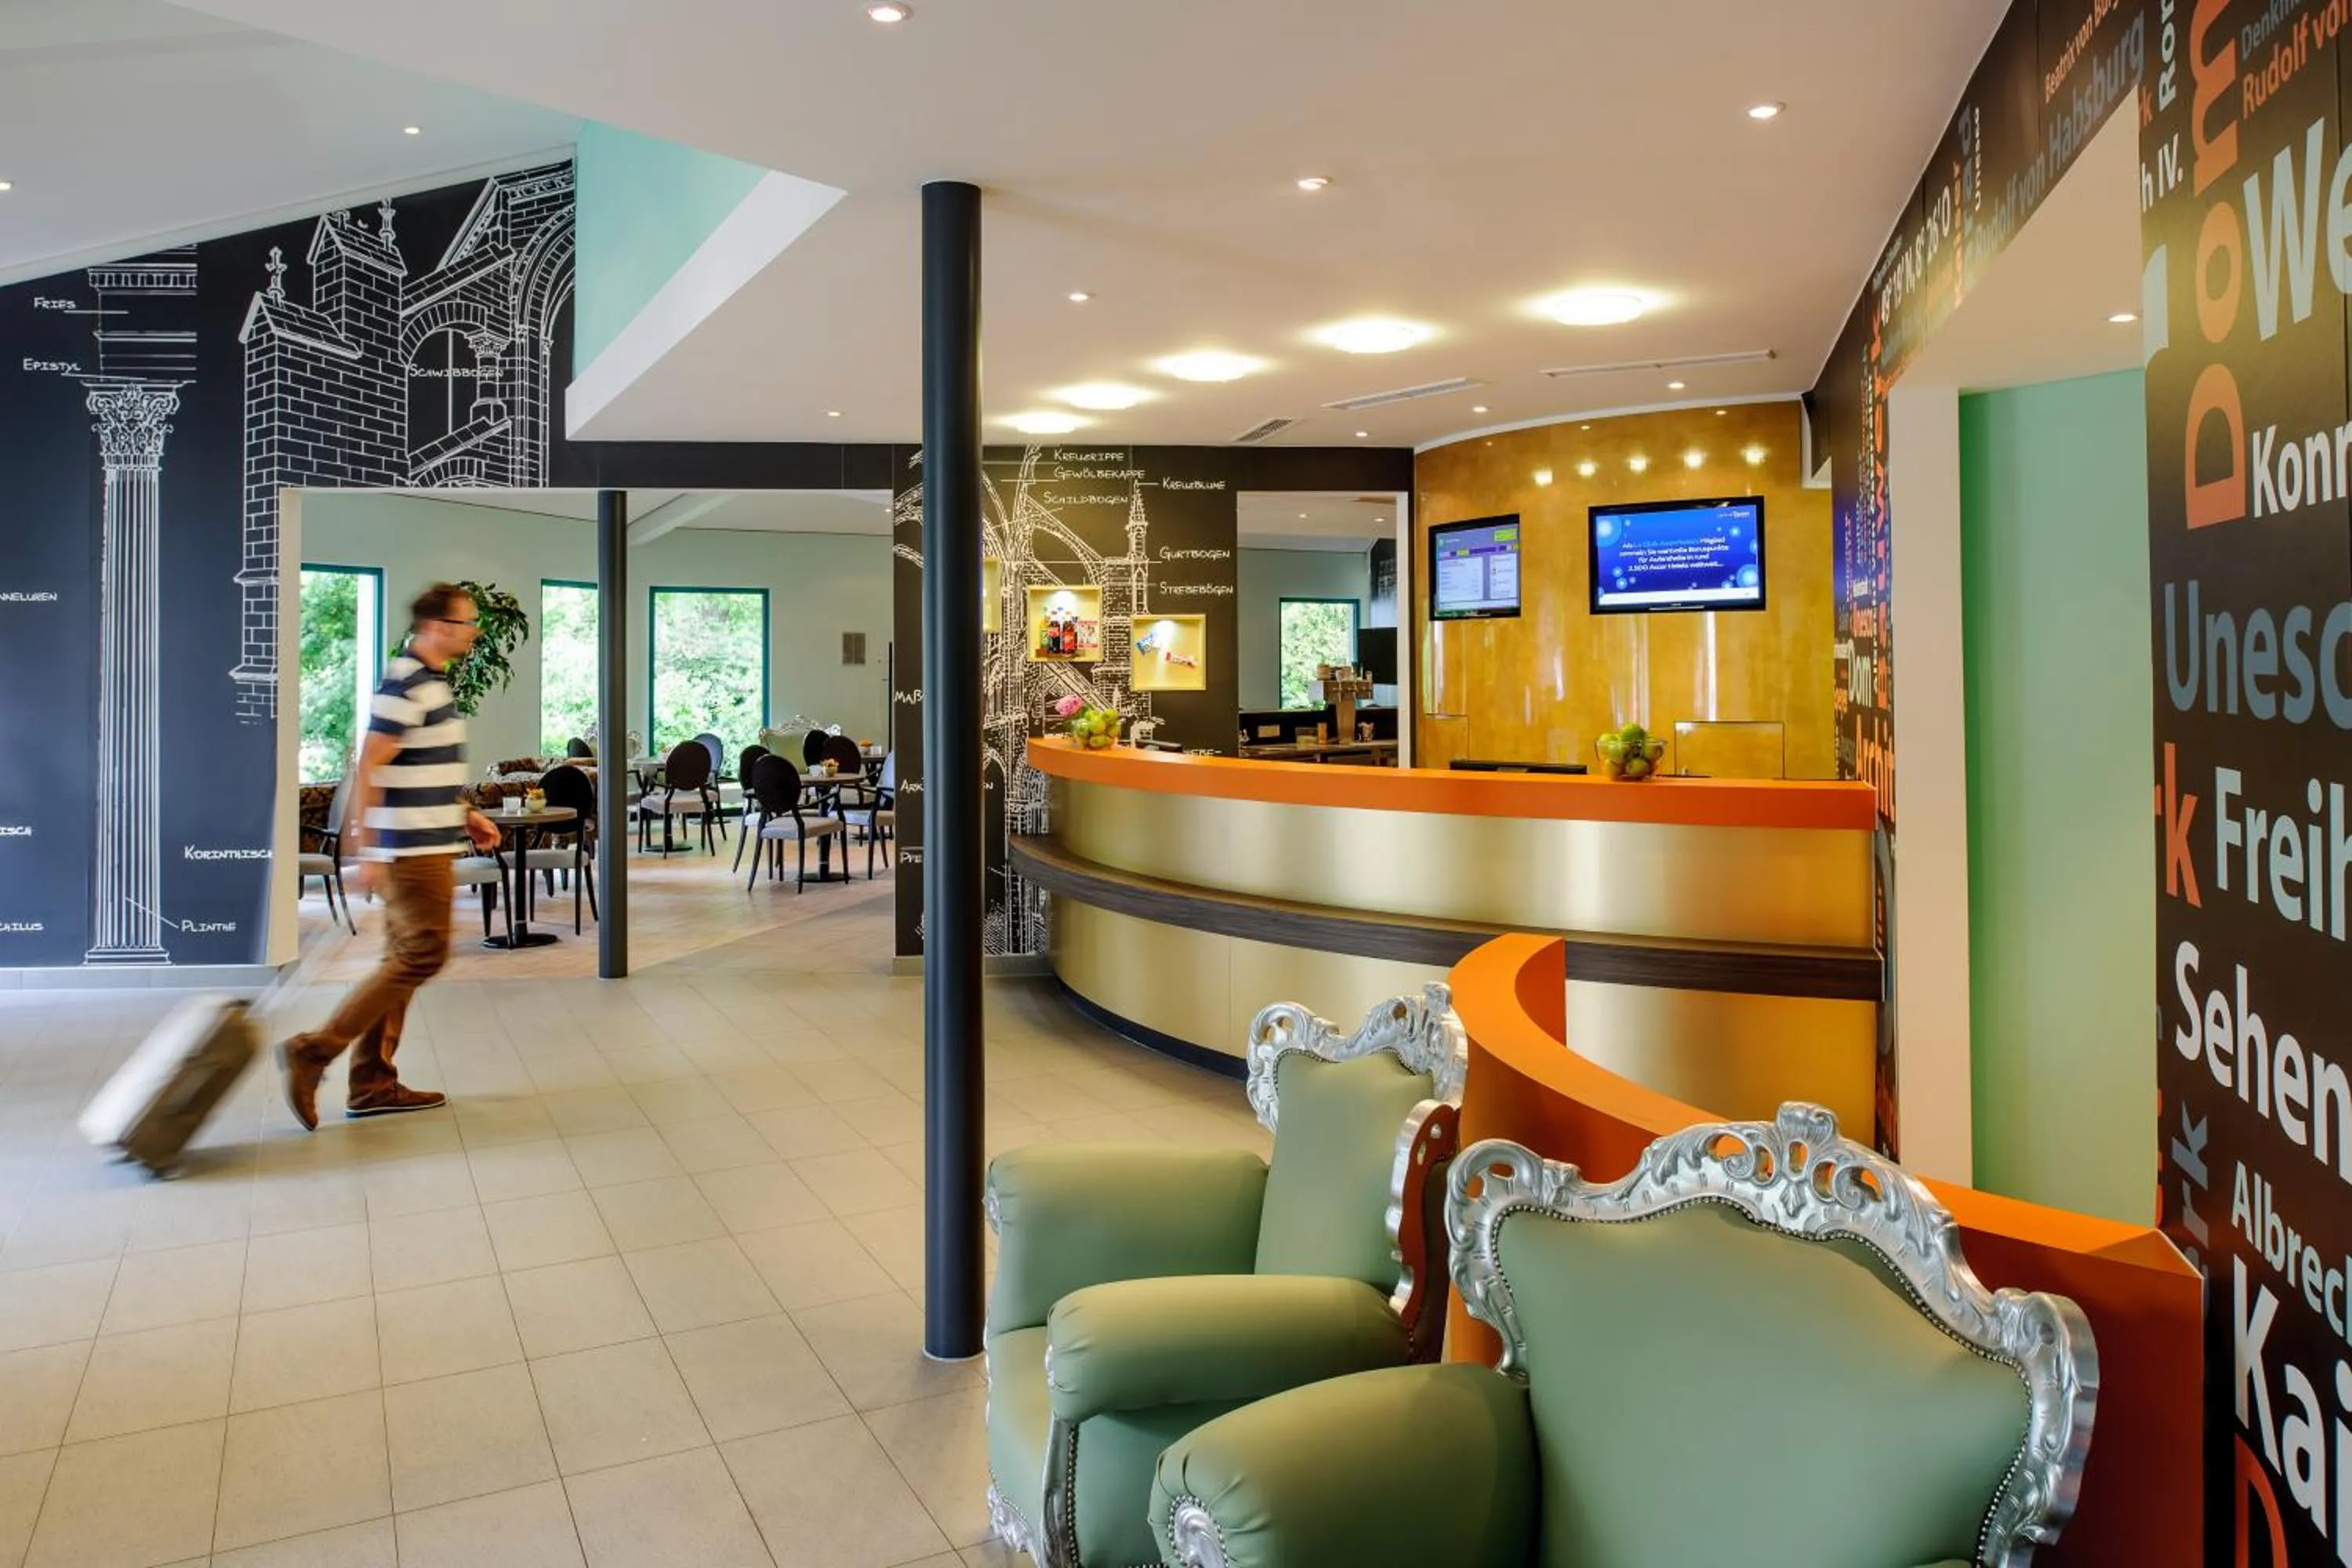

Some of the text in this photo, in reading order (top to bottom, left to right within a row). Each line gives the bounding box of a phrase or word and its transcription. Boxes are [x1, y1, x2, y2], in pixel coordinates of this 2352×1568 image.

[2049, 8, 2144, 180] Habsburg
[2243, 12, 2309, 120] Rudolf
[2158, 132, 2183, 198] IV.
